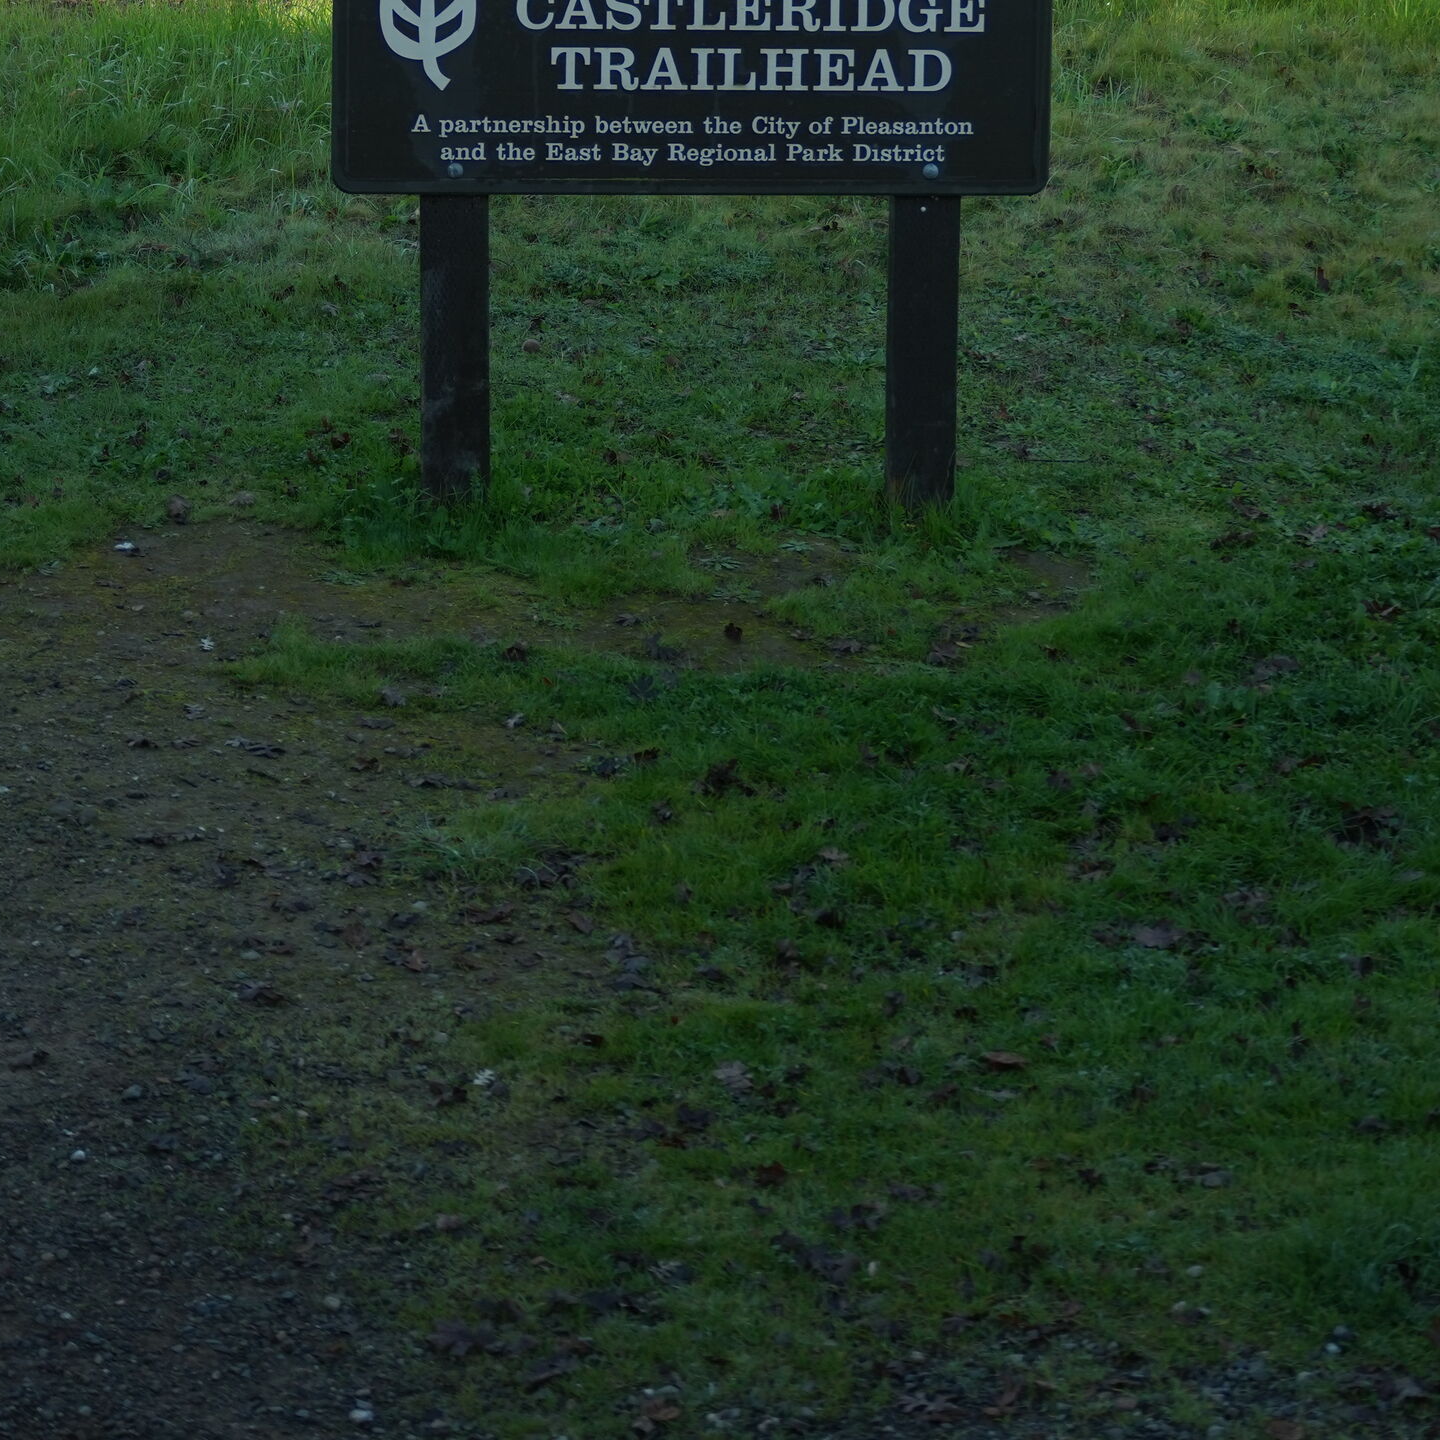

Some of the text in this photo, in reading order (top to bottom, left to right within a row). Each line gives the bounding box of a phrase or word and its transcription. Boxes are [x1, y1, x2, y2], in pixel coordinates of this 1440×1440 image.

[550, 47, 952, 92] TRAILHEAD
[411, 114, 974, 140] A partnership between the City of Pleasanton
[440, 142, 945, 167] and the East Bay Regional Park District
